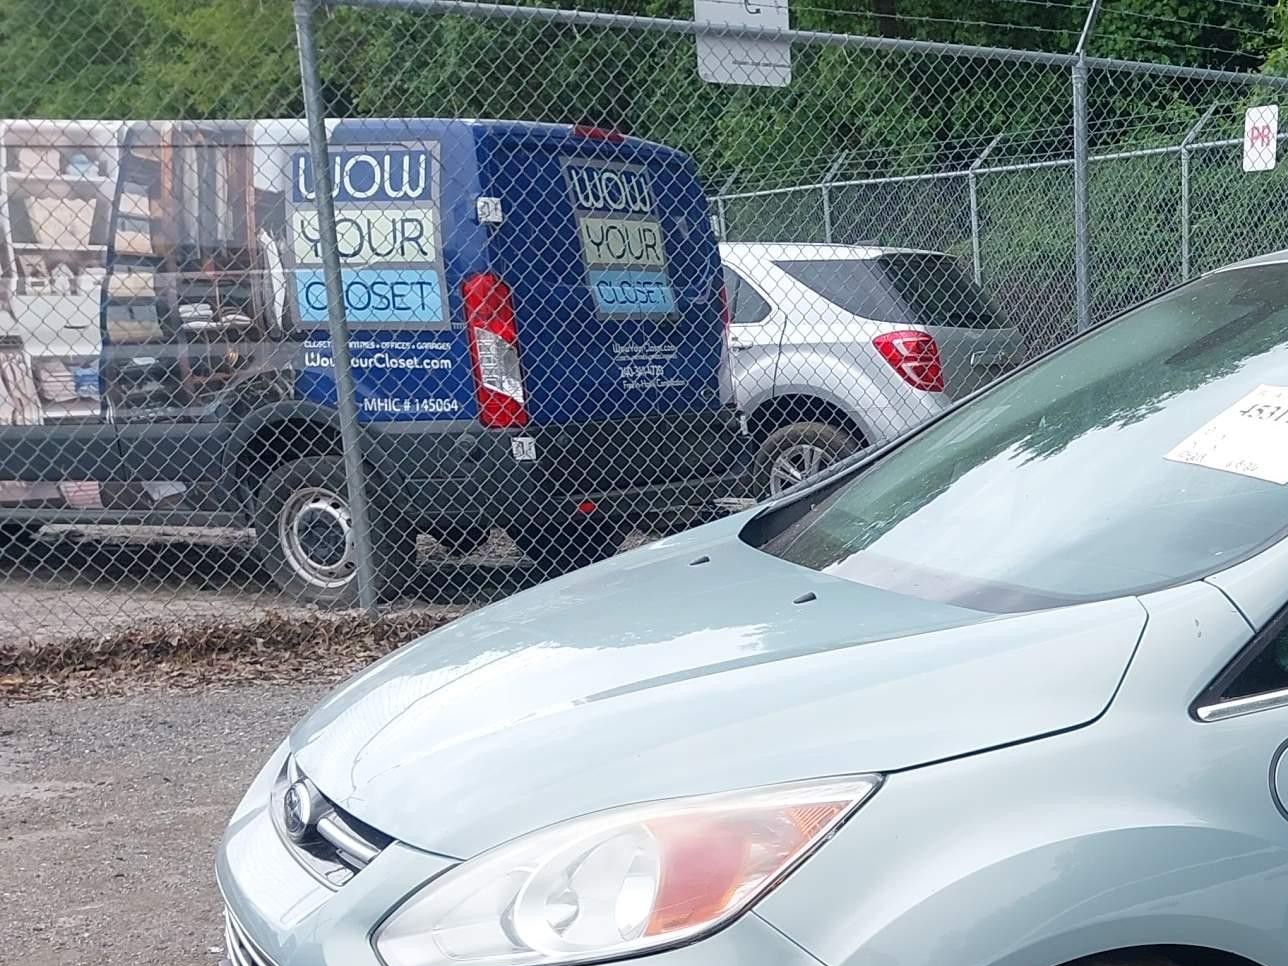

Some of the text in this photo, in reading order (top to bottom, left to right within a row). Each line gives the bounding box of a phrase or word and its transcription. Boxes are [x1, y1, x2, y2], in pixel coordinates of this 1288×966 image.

[299, 154, 426, 199] WOW
[570, 169, 651, 213] WOW
[585, 224, 660, 261] YOUR
[305, 281, 432, 311] COSET
[596, 279, 668, 305] CLOSET
[305, 353, 452, 369] WoourCloset.com
[364, 398, 458, 412] MHIC # 145064
